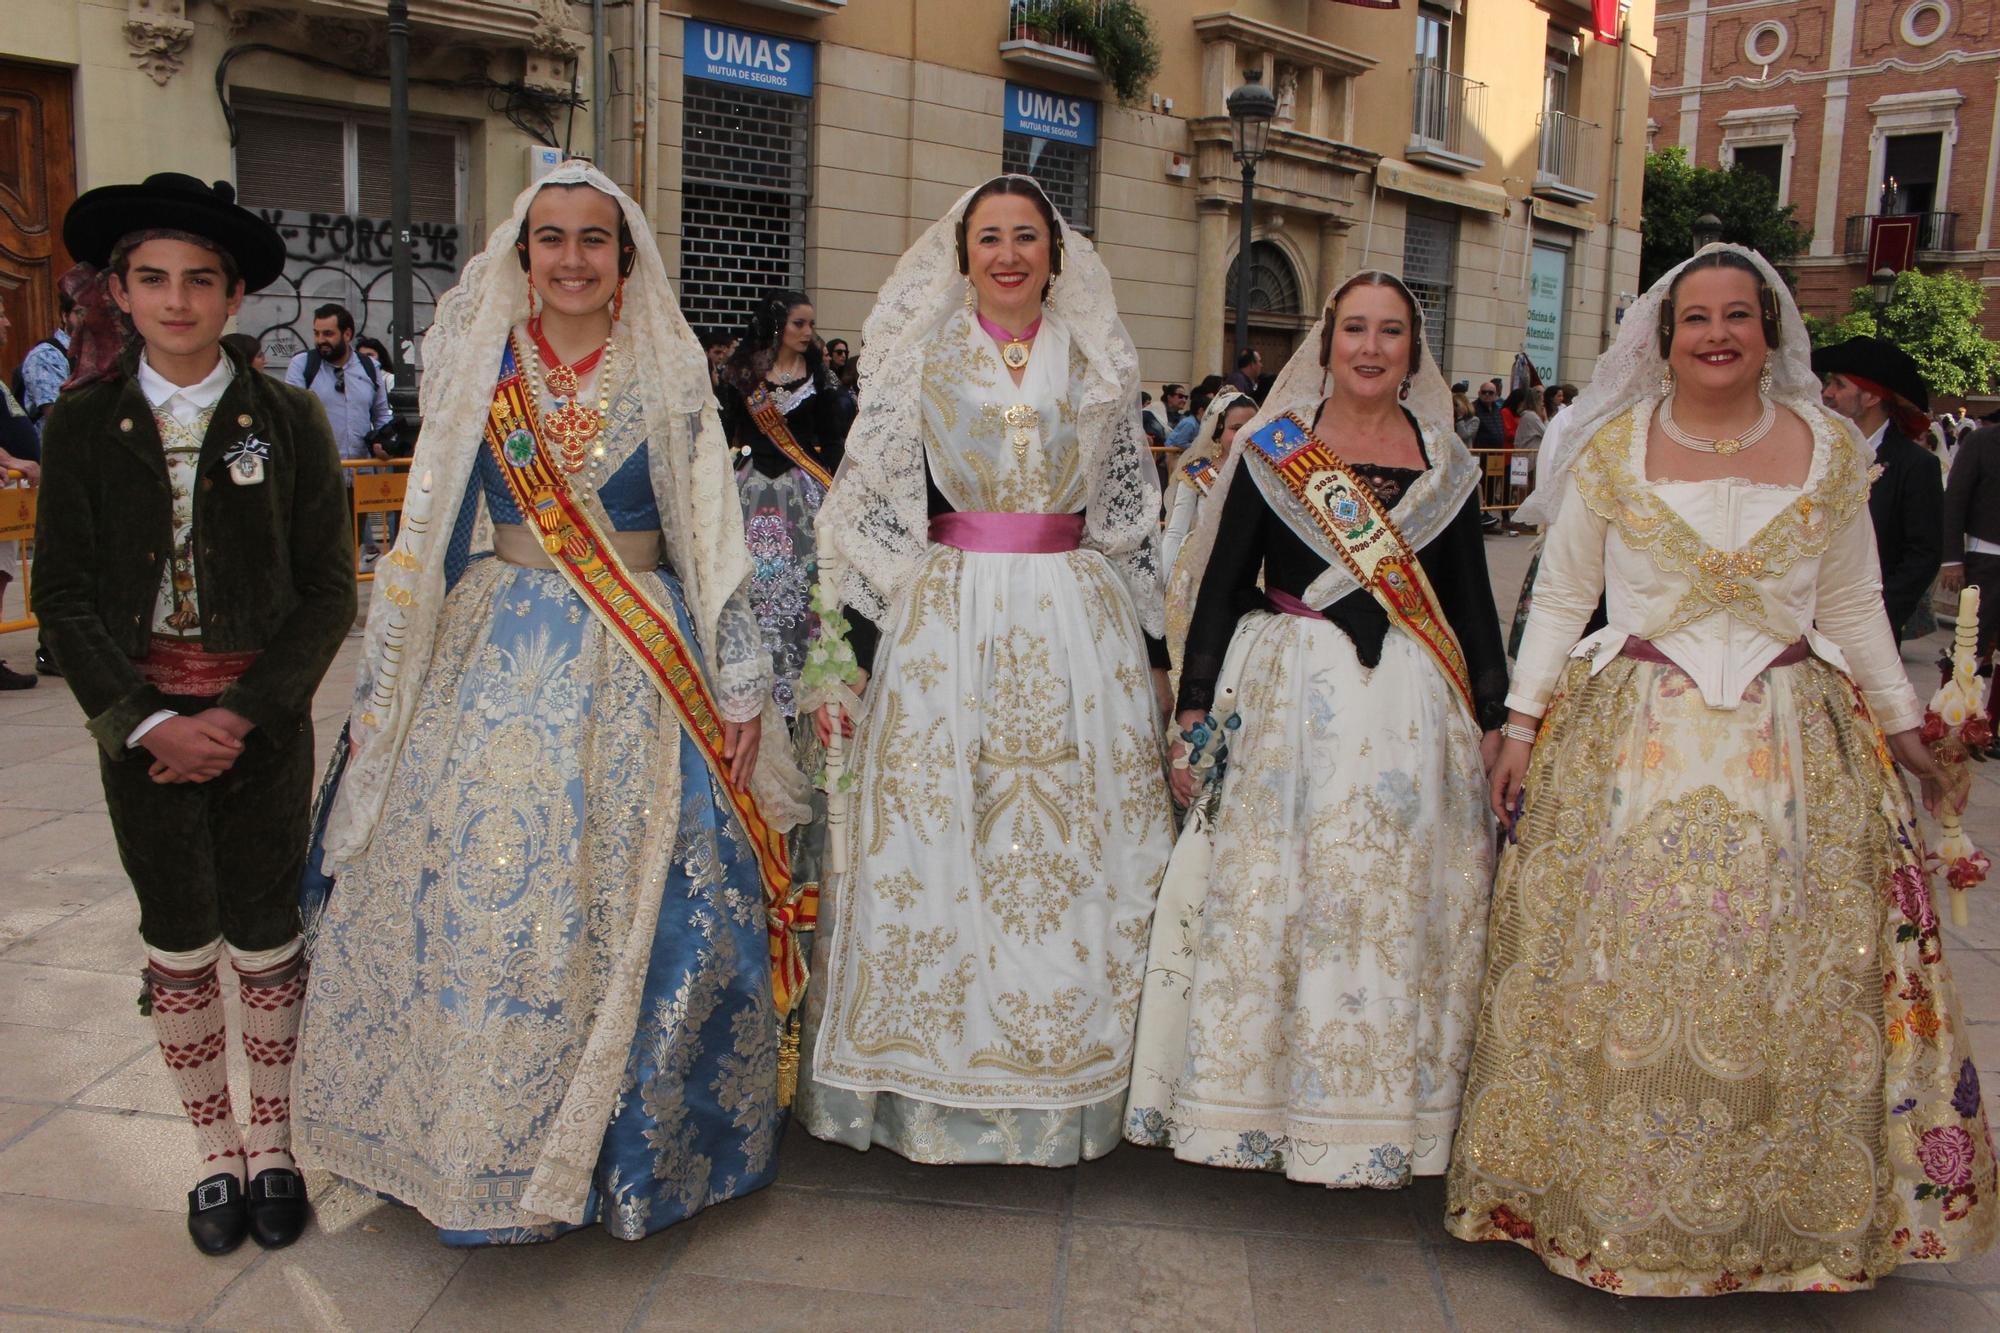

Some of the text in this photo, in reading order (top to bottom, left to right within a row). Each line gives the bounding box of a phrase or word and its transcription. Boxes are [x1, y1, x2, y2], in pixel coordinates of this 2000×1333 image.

[704, 28, 791, 73] UMAS
[707, 64, 788, 87] MUTUA DE SEGUROS
[1018, 90, 1081, 128] UMAS
[1020, 119, 1078, 139] MUTUA DE SEGUROS
[1527, 309, 1556, 324] Oficina de
[1526, 326, 1555, 340] Atención
[1314, 474, 1338, 491] 2022
[1350, 526, 1386, 553] 2020-2021
